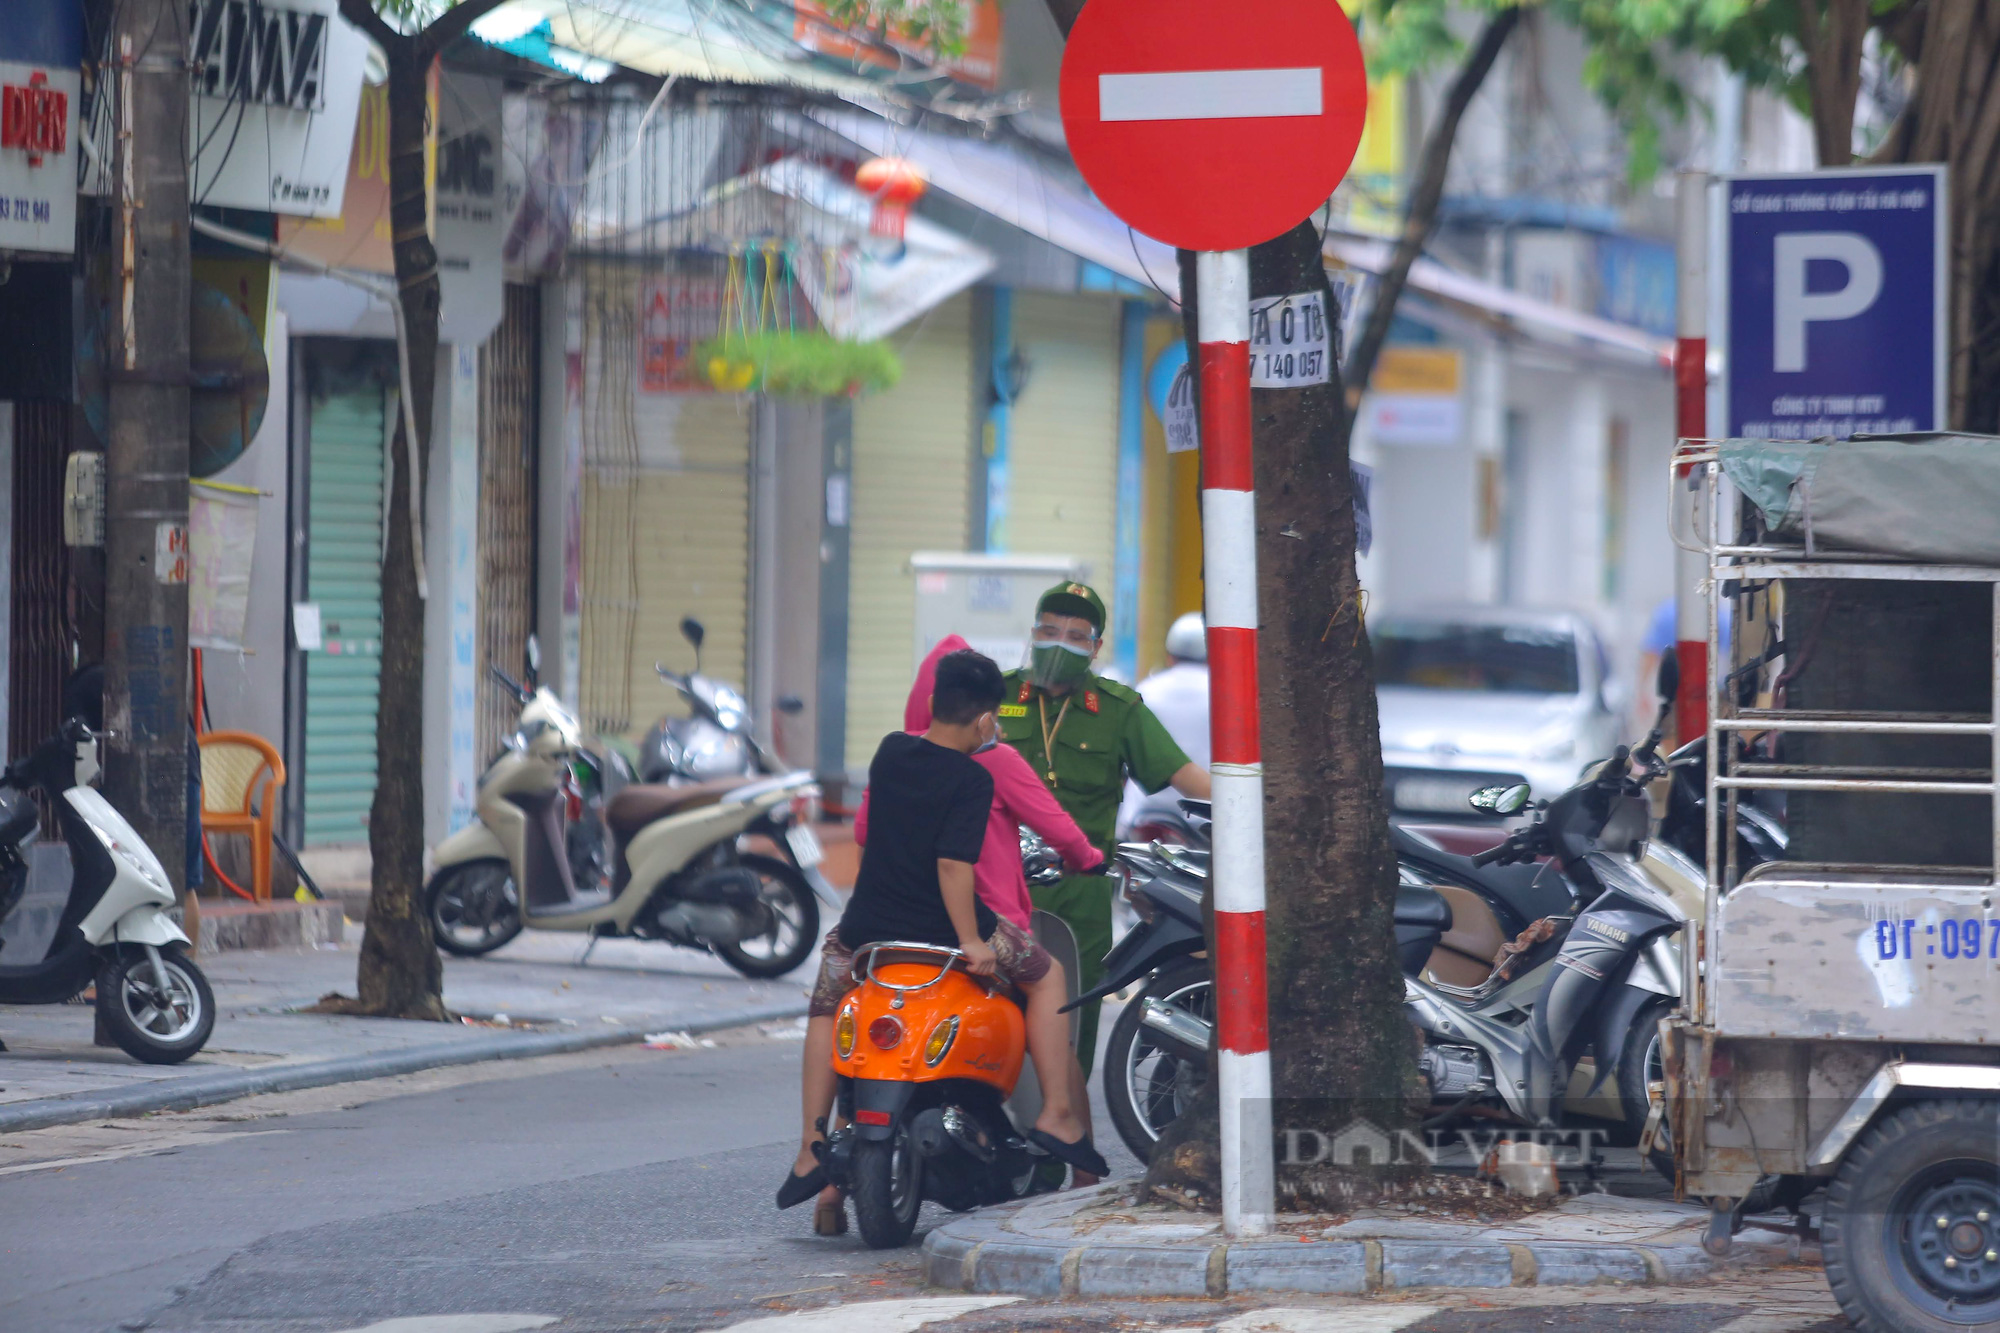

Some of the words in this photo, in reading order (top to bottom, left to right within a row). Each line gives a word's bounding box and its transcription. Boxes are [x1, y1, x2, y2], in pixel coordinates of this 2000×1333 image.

[14, 199, 29, 222] 212
[1773, 231, 1884, 373] P
[1263, 353, 1293, 379] 140
[1299, 350, 1323, 377] 057
[1012, 708, 1025, 716] 113
[1586, 918, 1628, 943] YAMAHA
